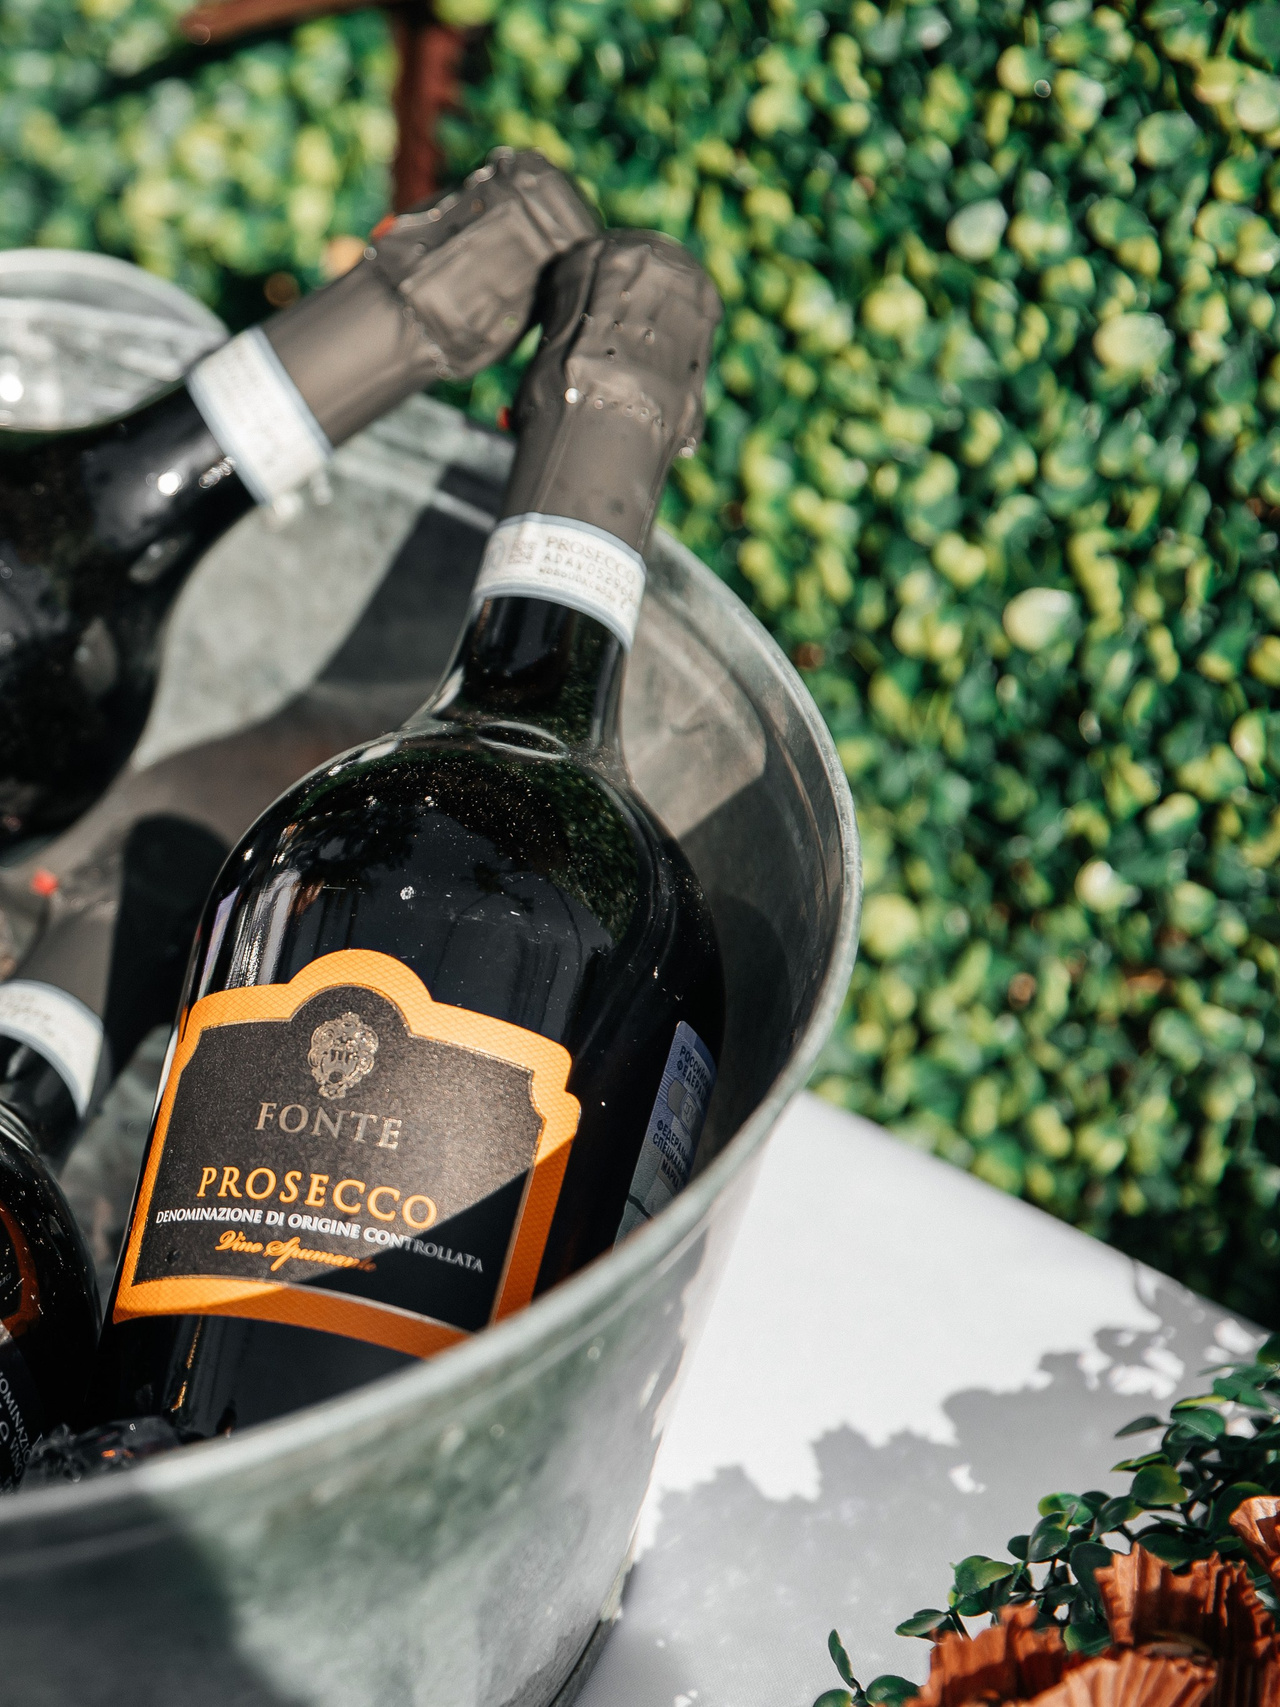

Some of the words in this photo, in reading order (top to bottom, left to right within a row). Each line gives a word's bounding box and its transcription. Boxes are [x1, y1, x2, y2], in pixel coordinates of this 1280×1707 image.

[546, 535, 636, 585] PROSECCO
[254, 1101, 403, 1150] FONTE
[196, 1165, 438, 1230] PROSECCO
[156, 1206, 263, 1225] DENOMINAZIONE
[265, 1210, 285, 1226] DI
[287, 1212, 361, 1240] ORIGINE
[362, 1226, 485, 1274] CONTROLLATA
[215, 1229, 265, 1254] Vino
[263, 1236, 378, 1273] Spumante
